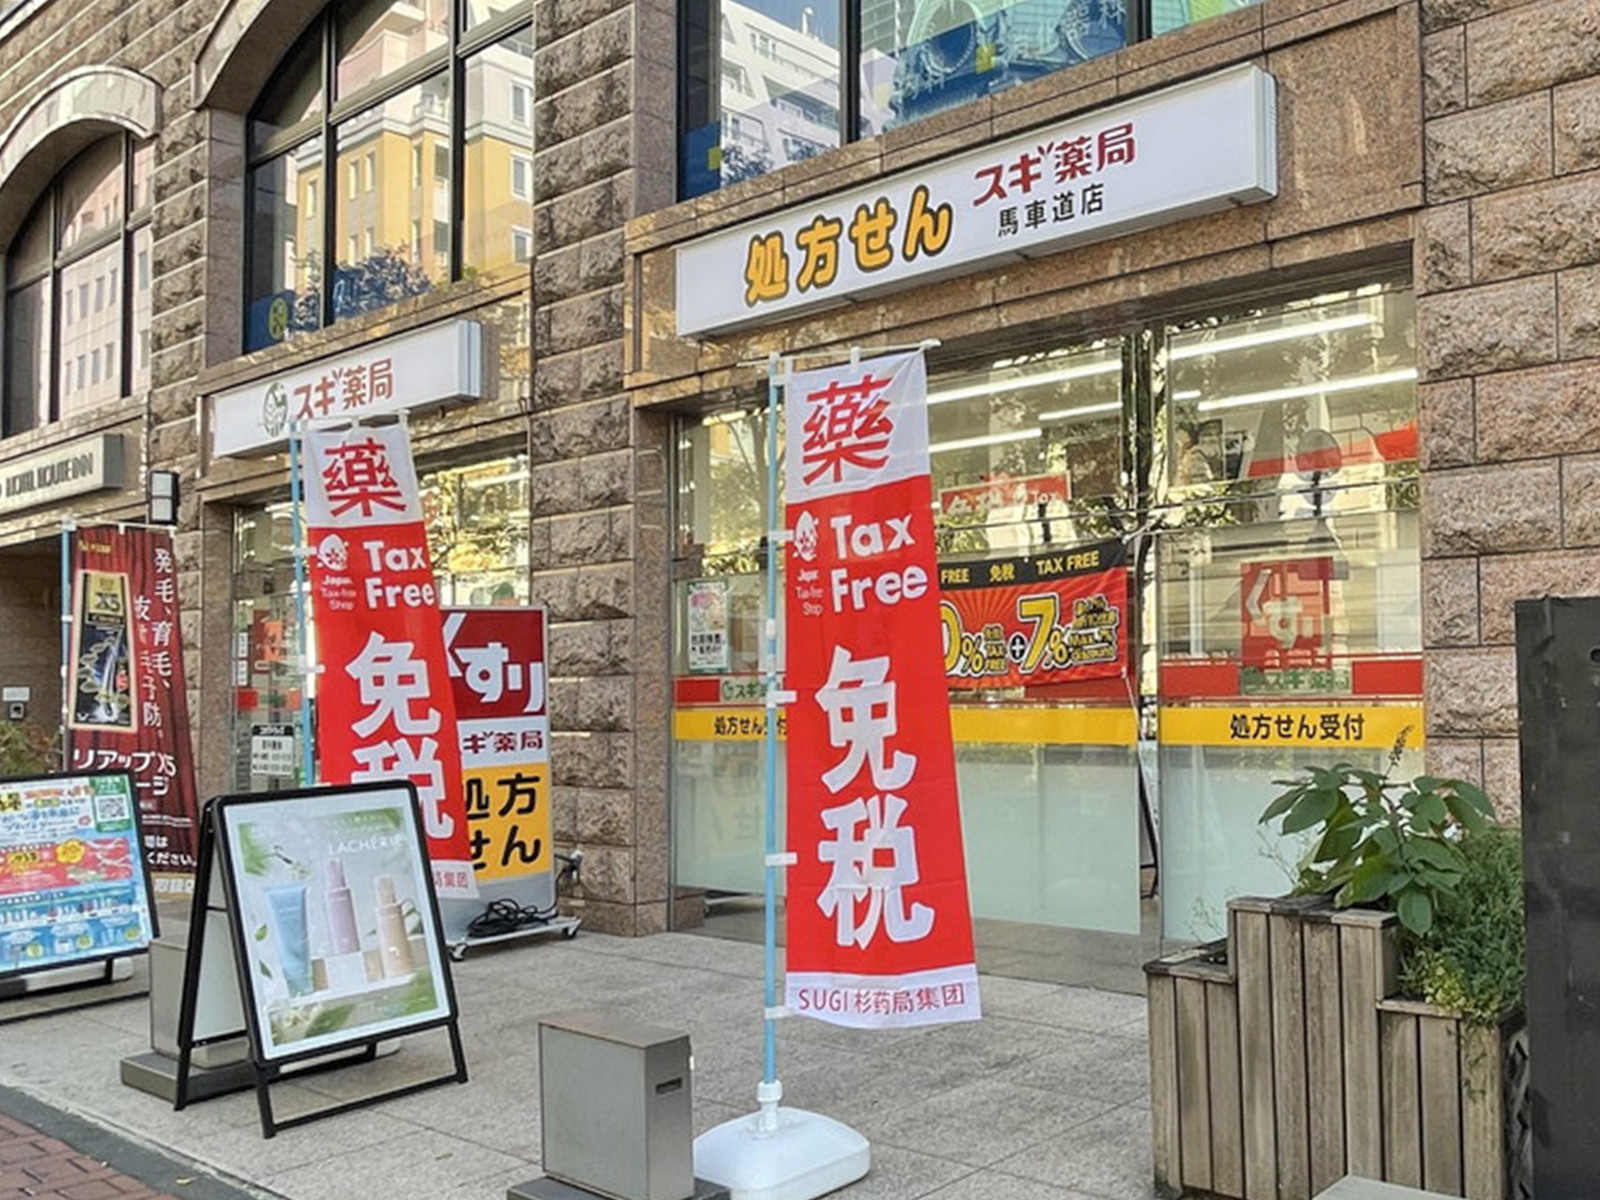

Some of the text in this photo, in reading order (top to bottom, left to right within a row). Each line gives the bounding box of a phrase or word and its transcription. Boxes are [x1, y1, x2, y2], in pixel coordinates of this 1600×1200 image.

[973, 122, 1136, 208] スギ薬局
[997, 183, 1105, 239] 馬車道店
[744, 184, 954, 307] 処方せん
[293, 358, 393, 420] スギ薬局
[363, 541, 427, 572] Tax
[830, 513, 916, 561] Tax
[940, 568, 970, 584] FREE
[1035, 550, 1100, 575] TAX FREE
[364, 577, 436, 609] Free
[830, 565, 928, 613] Free
[442, 612, 544, 713] くすり
[345, 630, 455, 839] 免税
[1230, 713, 1365, 741] 処方せん受付
[815, 644, 936, 950] 免税
[798, 981, 966, 1017] SUGI 杉药局集团
